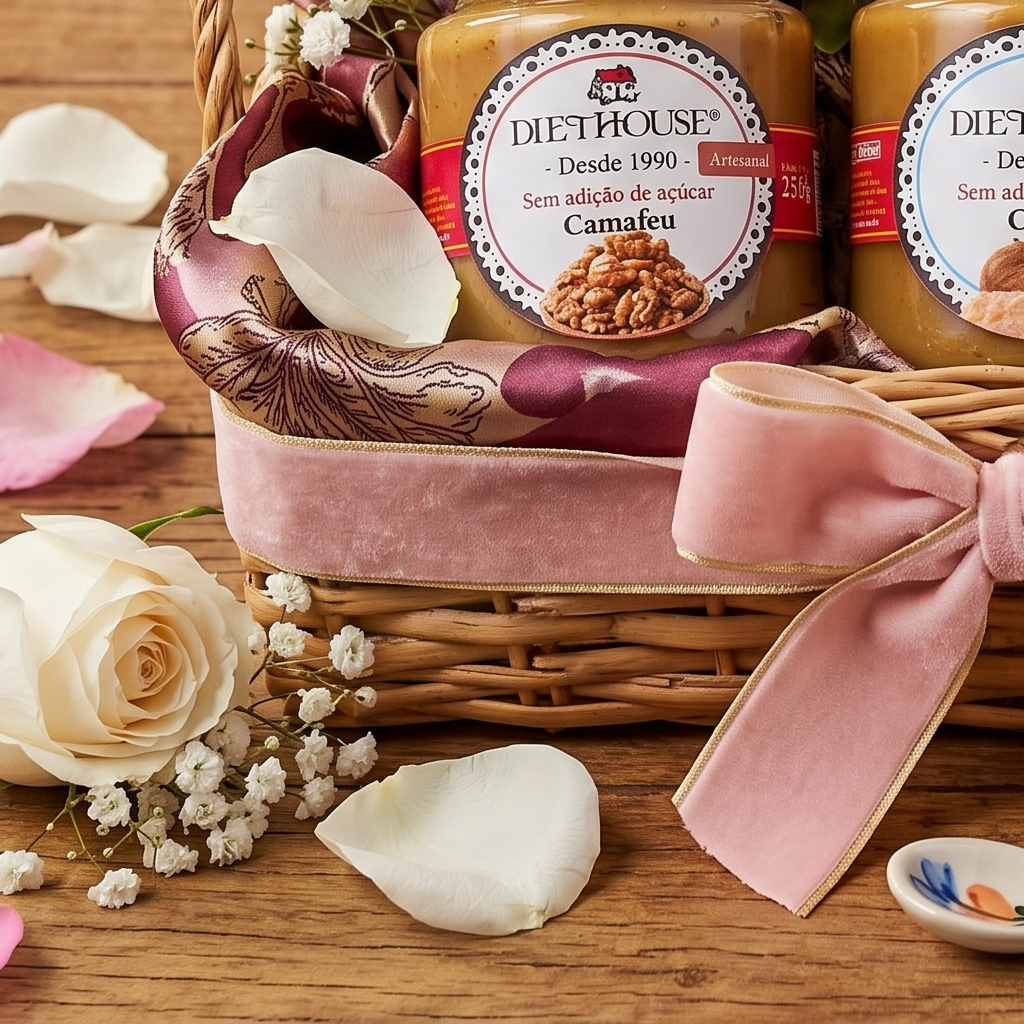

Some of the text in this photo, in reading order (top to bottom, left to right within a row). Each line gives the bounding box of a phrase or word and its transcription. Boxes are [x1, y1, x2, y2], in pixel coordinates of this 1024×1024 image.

[559, 154, 622, 176] Desde
[631, 151, 676, 171] 1990
[710, 152, 770, 168] Artesanal
[523, 184, 715, 210] Sem adição de açúcar
[957, 184, 997, 201] Sem
[564, 207, 676, 235] Camafeu
